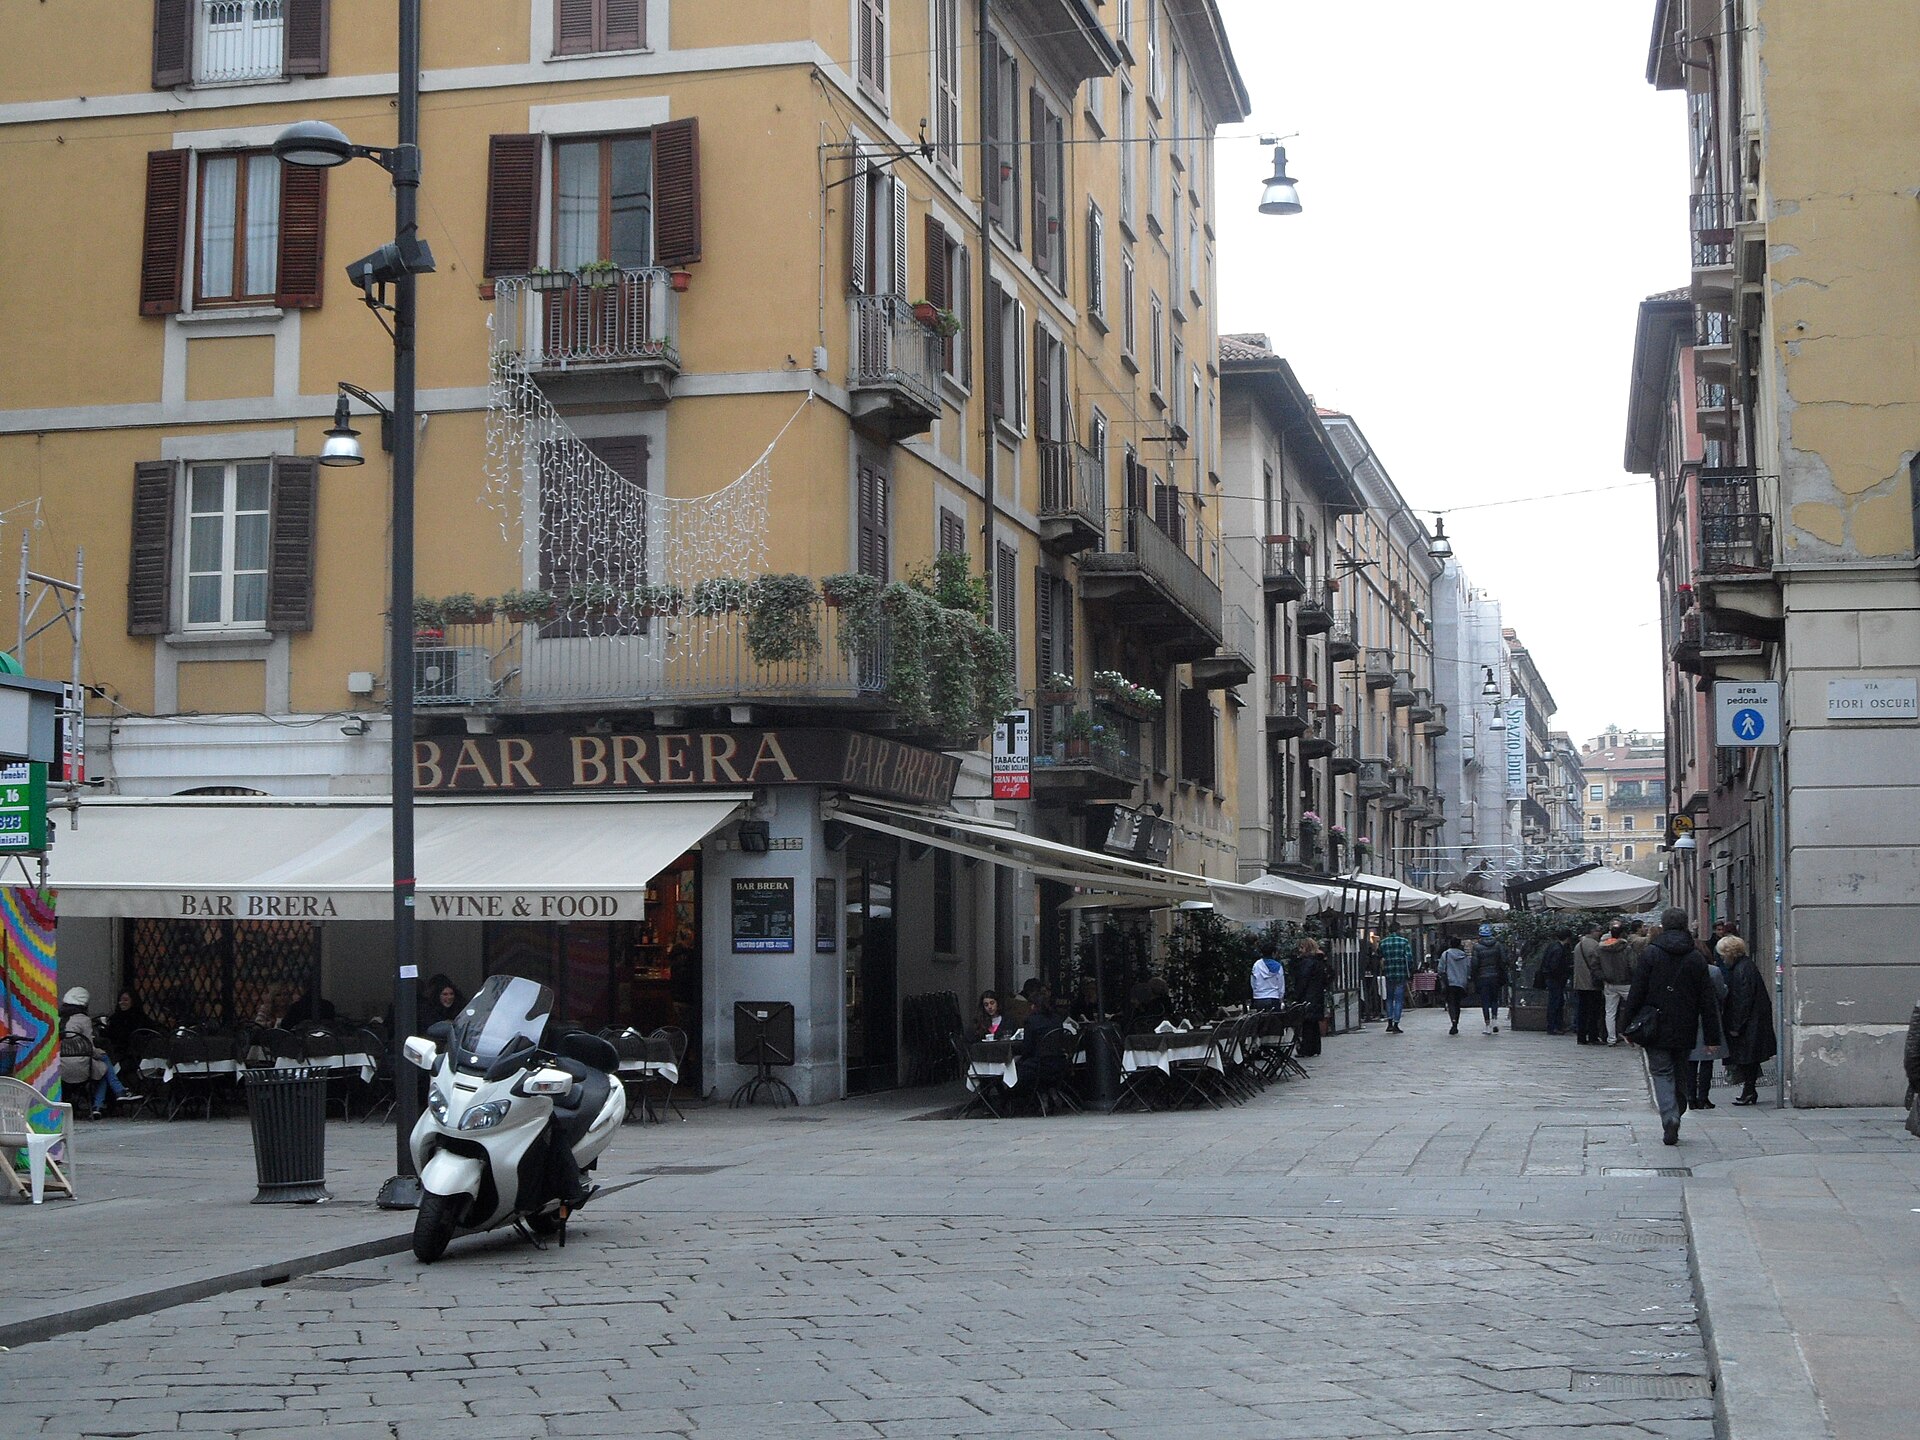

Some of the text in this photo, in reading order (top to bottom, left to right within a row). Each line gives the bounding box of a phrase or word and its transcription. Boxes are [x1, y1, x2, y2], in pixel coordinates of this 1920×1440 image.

[1727, 696, 1768, 705] pedonale
[1829, 699, 1915, 709] FIORI OSCURI
[997, 715, 1025, 754] T
[1506, 710, 1523, 749] SPAZIO
[413, 732, 798, 788] BAR BRERA
[842, 734, 954, 802] BAR BRERA
[994, 756, 1029, 764] TABACCHI
[1507, 753, 1524, 784] EDILE
[1, 769, 27, 779] funebri
[993, 775, 1010, 783] GRAN
[6, 789, 20, 802] 16
[757, 882, 789, 890] BRERA
[180, 895, 339, 917] BAR BRERA
[429, 895, 618, 917] WINE & FOOD
